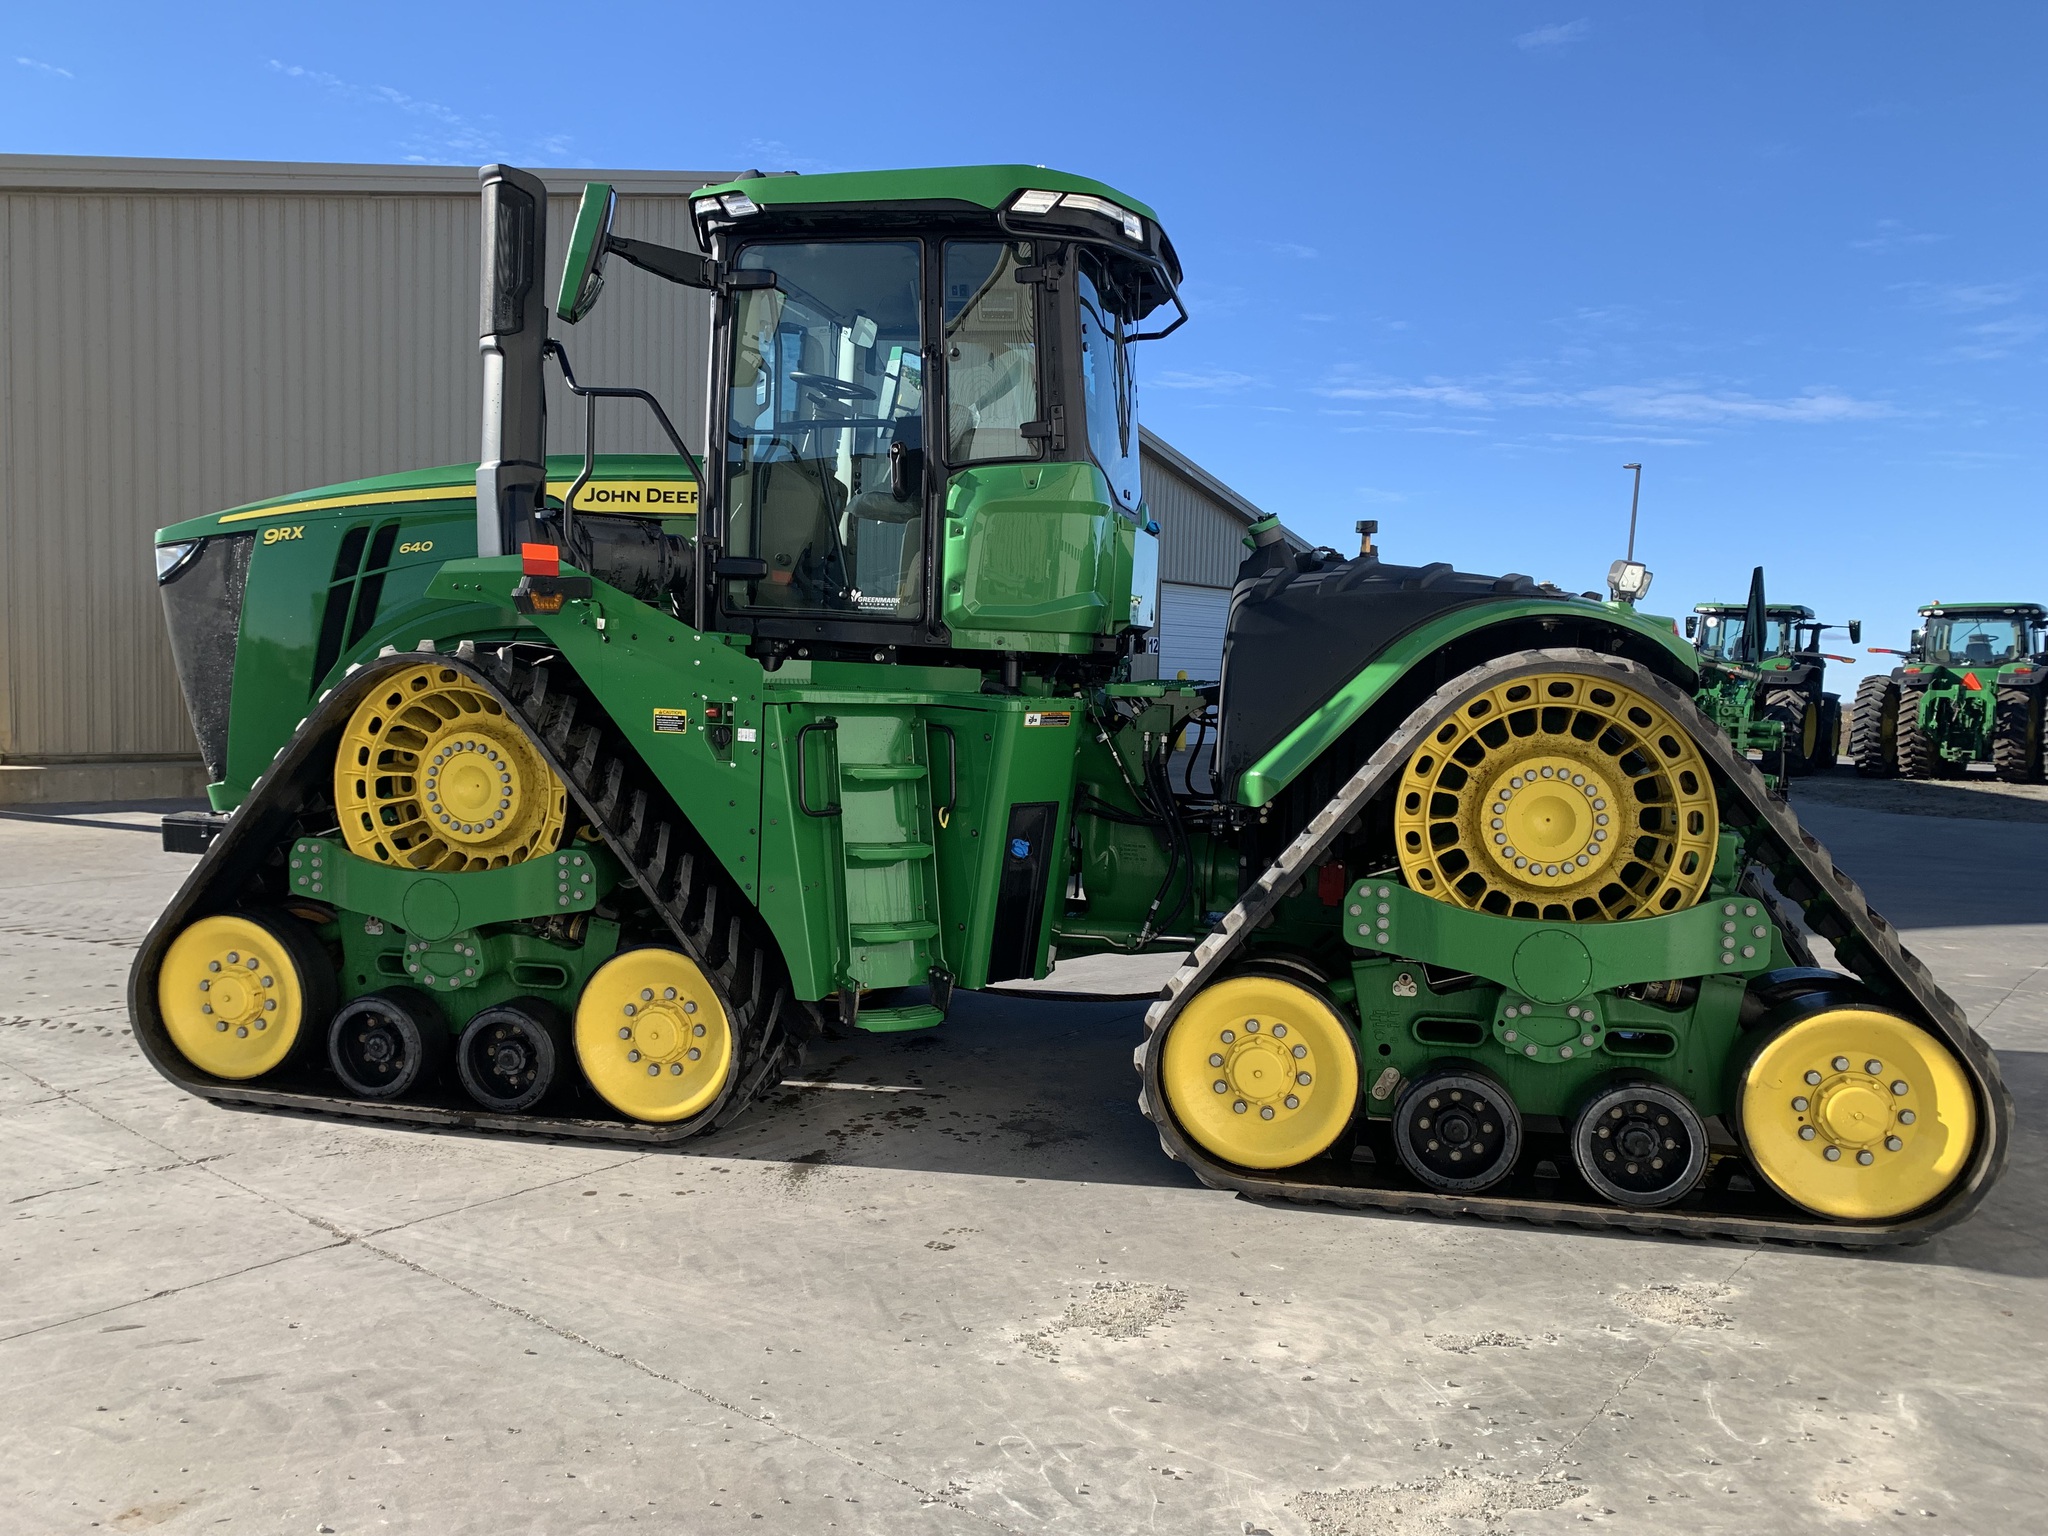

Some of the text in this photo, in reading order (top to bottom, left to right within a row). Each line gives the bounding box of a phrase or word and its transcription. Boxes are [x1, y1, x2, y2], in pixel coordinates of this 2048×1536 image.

[584, 488, 640, 503] JOHN
[263, 525, 305, 545] 9RX
[400, 541, 433, 554] 640
[857, 596, 901, 604] GREENMARK
